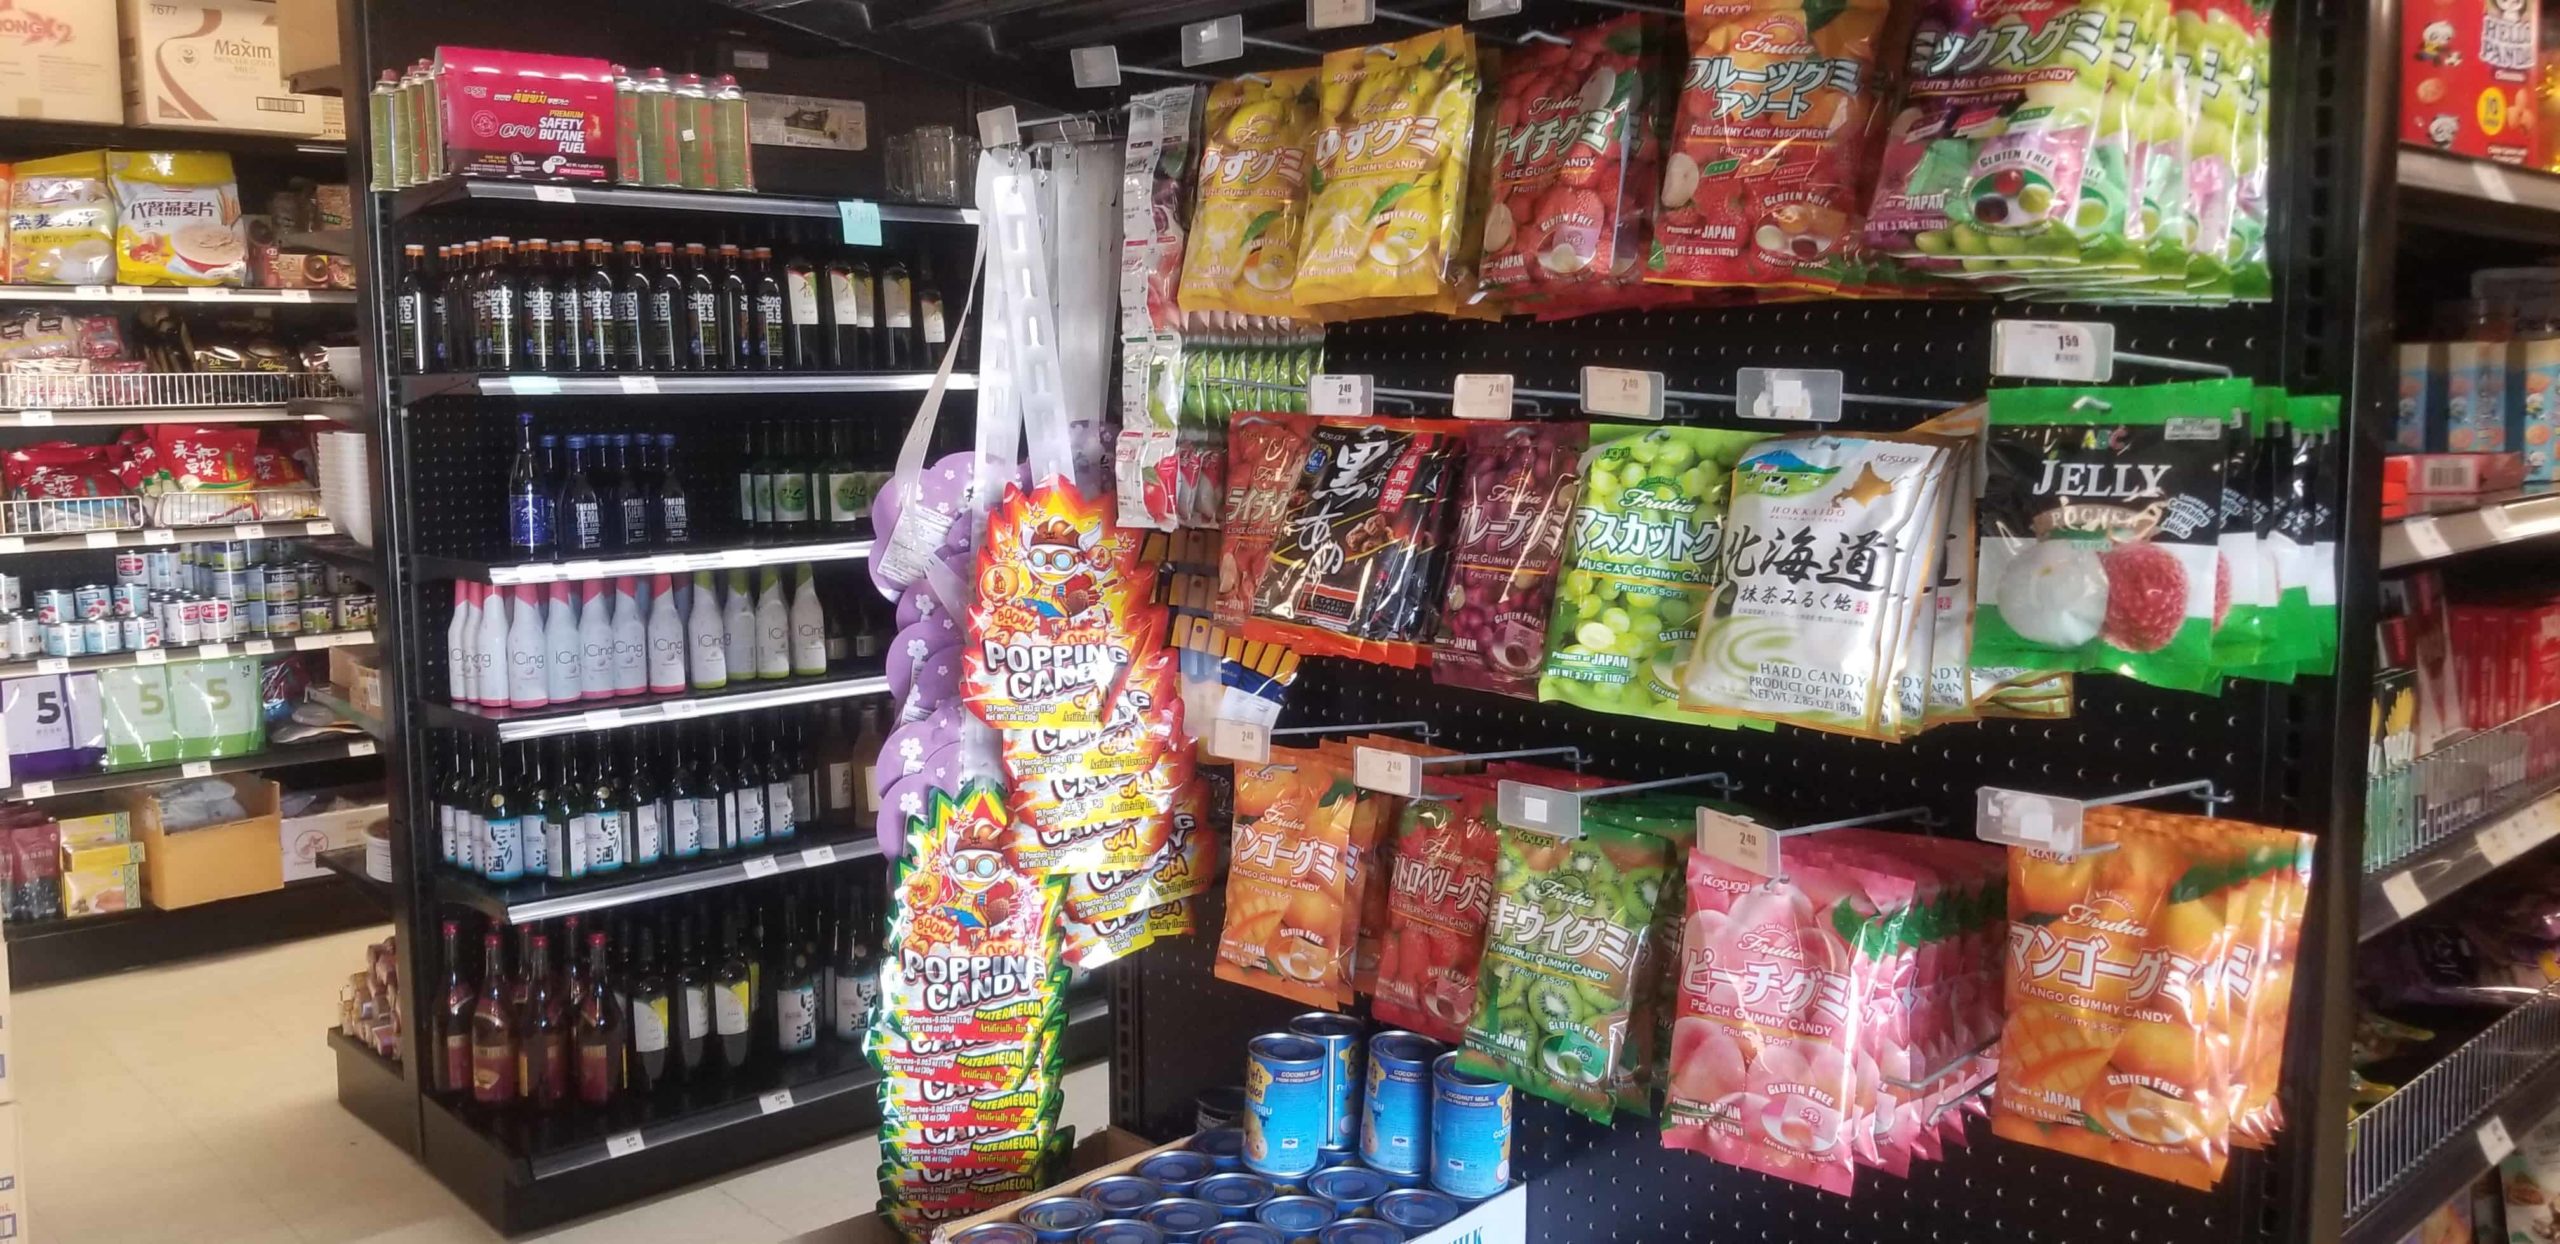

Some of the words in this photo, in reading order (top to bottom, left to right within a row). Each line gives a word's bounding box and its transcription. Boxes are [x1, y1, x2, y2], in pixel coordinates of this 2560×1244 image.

[214, 38, 272, 59] Maxim
[1735, 31, 1815, 55] Frutia
[1911, 13, 2107, 76] ミックスグミ
[1683, 57, 1860, 96] フルーツグミ
[1910, 80, 1949, 92] FRUITS
[1951, 77, 1976, 89] MIX
[1978, 73, 2024, 86] GUMMY
[2026, 68, 2076, 82] CANDY
[550, 110, 584, 118] PREMIUM
[1528, 95, 1584, 115] Frutia
[1712, 91, 1812, 121] アソート
[539, 117, 584, 130] SAFETY
[1690, 125, 1712, 136] FRUIT
[1713, 125, 1742, 137] GUMMY
[1743, 126, 1770, 137] CANDY
[1772, 127, 1830, 139] ASSORTMENT
[539, 129, 585, 142] BUTANE
[1316, 115, 1441, 169] ゆずグミ
[558, 142, 586, 154] FUEL
[1346, 163, 1383, 175] GUMMY
[1385, 158, 1426, 170] CANDY
[1980, 150, 2022, 168] GLUTEN
[1763, 191, 1803, 207] GLUTEN
[1906, 194, 1944, 210] JAPAN
[1541, 213, 1569, 231] GLUTEN
[1571, 213, 1594, 226] FREE
[1701, 225, 1736, 240] JAPAN
[404, 295, 414, 324] Cool
[603, 290, 613, 320] Cool
[627, 291, 638, 320] Cool
[173, 440, 220, 459] 永和
[2082, 428, 2128, 450] ABC
[2032, 460, 2172, 497] JELLY
[1619, 488, 1697, 514] Frutia
[1770, 505, 1846, 518] HOKKAIDO
[664, 505, 687, 519] SIERRA
[2168, 498, 2210, 527] Contains
[2171, 509, 2198, 528] Fruit
[2160, 518, 2192, 539] Juice
[1480, 553, 1515, 567] GUMMY
[1518, 558, 1548, 568] CANDY
[1726, 525, 1889, 592] 北海道
[1577, 559, 1630, 574] MUSCAT
[1631, 565, 1678, 580] GUMMY
[1615, 582, 1650, 594] FRUITY
[1659, 588, 1684, 598] SOFT
[1739, 586, 1853, 611] 抹茶みるく飴
[997, 606, 1035, 631] BOOM!
[1495, 612, 1522, 625] GLUTEN
[1522, 612, 1541, 628] FREE
[1454, 637, 1477, 651] JAPAN
[1658, 630, 1696, 642] GLUTEN
[984, 640, 1128, 674] POPPING
[1591, 653, 1629, 669] JAPAN
[1760, 663, 1803, 680] HARD
[1807, 667, 1867, 688] CANDY
[140, 682, 164, 715] 5
[206, 678, 231, 710] 5
[1749, 676, 1800, 693] PRODUCT
[1805, 684, 1822, 696] OF
[1824, 687, 1864, 702] JAPAN
[1750, 688, 1767, 701] NET
[37, 691, 61, 724] 5
[1090, 758, 1124, 770] Artificially
[1260, 808, 1306, 831] Frutia
[1103, 825, 1137, 851] COLA
[1153, 853, 1188, 882] COLA
[1232, 865, 1258, 879] MANGO
[1259, 871, 1288, 887] GUMMY
[1290, 879, 1320, 893] CANDY
[1702, 873, 1751, 893] Kasugai
[1535, 878, 1597, 908] Frutia
[916, 917, 951, 940] BOOM!
[1426, 909, 1449, 923] GUMMY
[1450, 917, 1474, 931] CANDY
[2062, 903, 2149, 937] Frutia
[1280, 928, 1304, 938] GLUTEN
[1305, 930, 1325, 945] FREE
[1488, 893, 1633, 973] キウイグミ
[1243, 943, 1266, 957] JAPAN
[1738, 933, 1804, 960] Frutia
[903, 949, 1045, 983] POPPING
[1490, 941, 1536, 963] KIWIFRUIT
[1536, 953, 1572, 972] GUMMY
[1572, 965, 1609, 982] CANDY
[2007, 921, 2197, 1006] マンゴーグミ
[1514, 967, 1541, 980] FRUITY
[1549, 976, 1570, 988] SOFT
[1683, 948, 1850, 1025] ピーチグミ
[926, 974, 1031, 1012] CANDY
[2020, 981, 2064, 1002] MANGO
[2068, 994, 2121, 1015] GUMMY
[2123, 1005, 2173, 1023] CANDY
[975, 1001, 1042, 1021] WATERMELON
[1690, 999, 1730, 1016] PEACH
[1733, 1006, 1785, 1028] GUMMY
[1788, 1019, 1833, 1037] CANDY
[2054, 1013, 2088, 1029] FRUITY
[979, 1023, 1013, 1035] Artificially
[1549, 1020, 1581, 1033] GLUTEN
[1583, 1025, 1604, 1044] FREE
[1496, 1032, 1527, 1051] JAPAN
[1765, 1035, 1793, 1047] SOFT
[956, 1050, 1024, 1068] WATERMELON
[960, 1068, 994, 1081] Artificially
[1767, 1083, 1805, 1096] GLUTEN
[1807, 1084, 1835, 1107] FREE
[2107, 1074, 2151, 1086] GLUTEN
[2153, 1077, 2185, 1098] FREE
[971, 1091, 1038, 1110] WATERMELON
[2043, 1090, 2082, 1111] JAPAN
[975, 1113, 1008, 1123] Artificially
[1709, 1102, 1742, 1121] JAPAN
[972, 1135, 1038, 1152] WATERMELON
